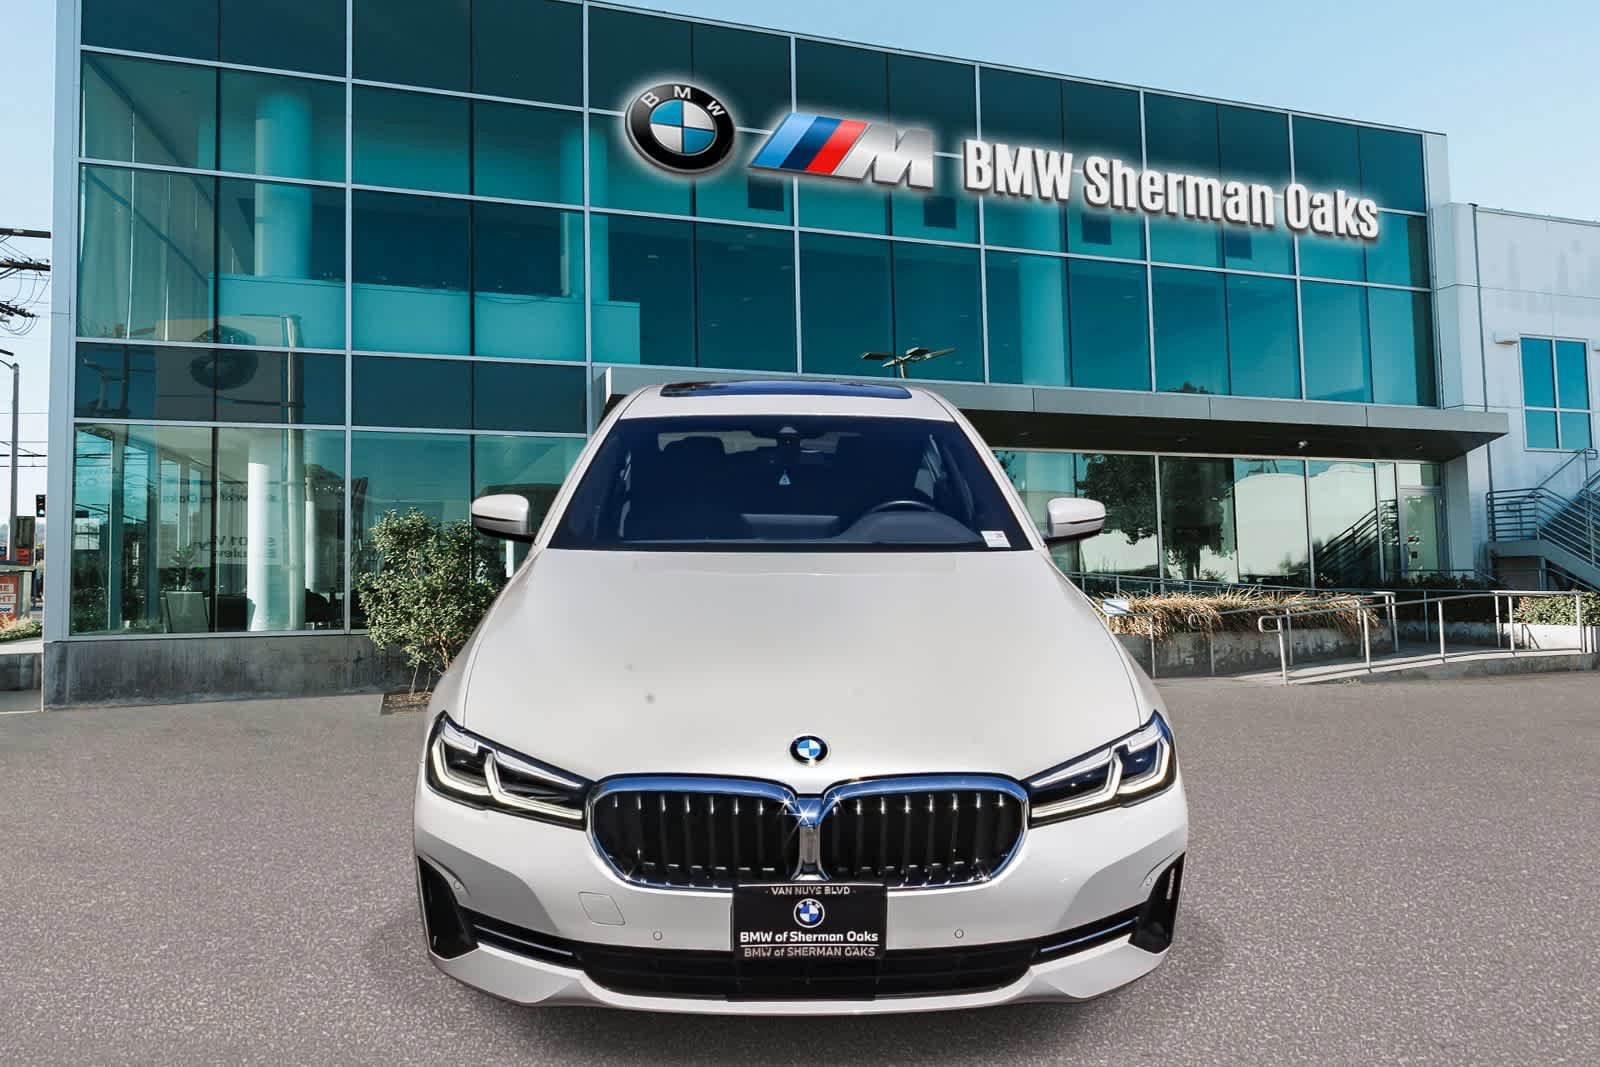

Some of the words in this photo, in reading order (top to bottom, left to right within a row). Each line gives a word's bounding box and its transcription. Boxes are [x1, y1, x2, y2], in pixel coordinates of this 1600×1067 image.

[641, 84, 726, 118] BMW
[963, 139, 1073, 201] BMW
[1083, 155, 1276, 226] Sherman
[1284, 182, 1379, 240] Oaks
[771, 886, 793, 895] VAN
[795, 886, 822, 895] NUYS
[824, 886, 850, 895] BLVD
[740, 931, 773, 942] BMW
[775, 931, 789, 942] of
[790, 931, 844, 942] Sherman
[846, 930, 879, 942] Oaks
[744, 947, 772, 957] BMW
[774, 947, 785, 957] of
[786, 946, 842, 957] SHERMAN
[844, 946, 876, 957] OAKS
